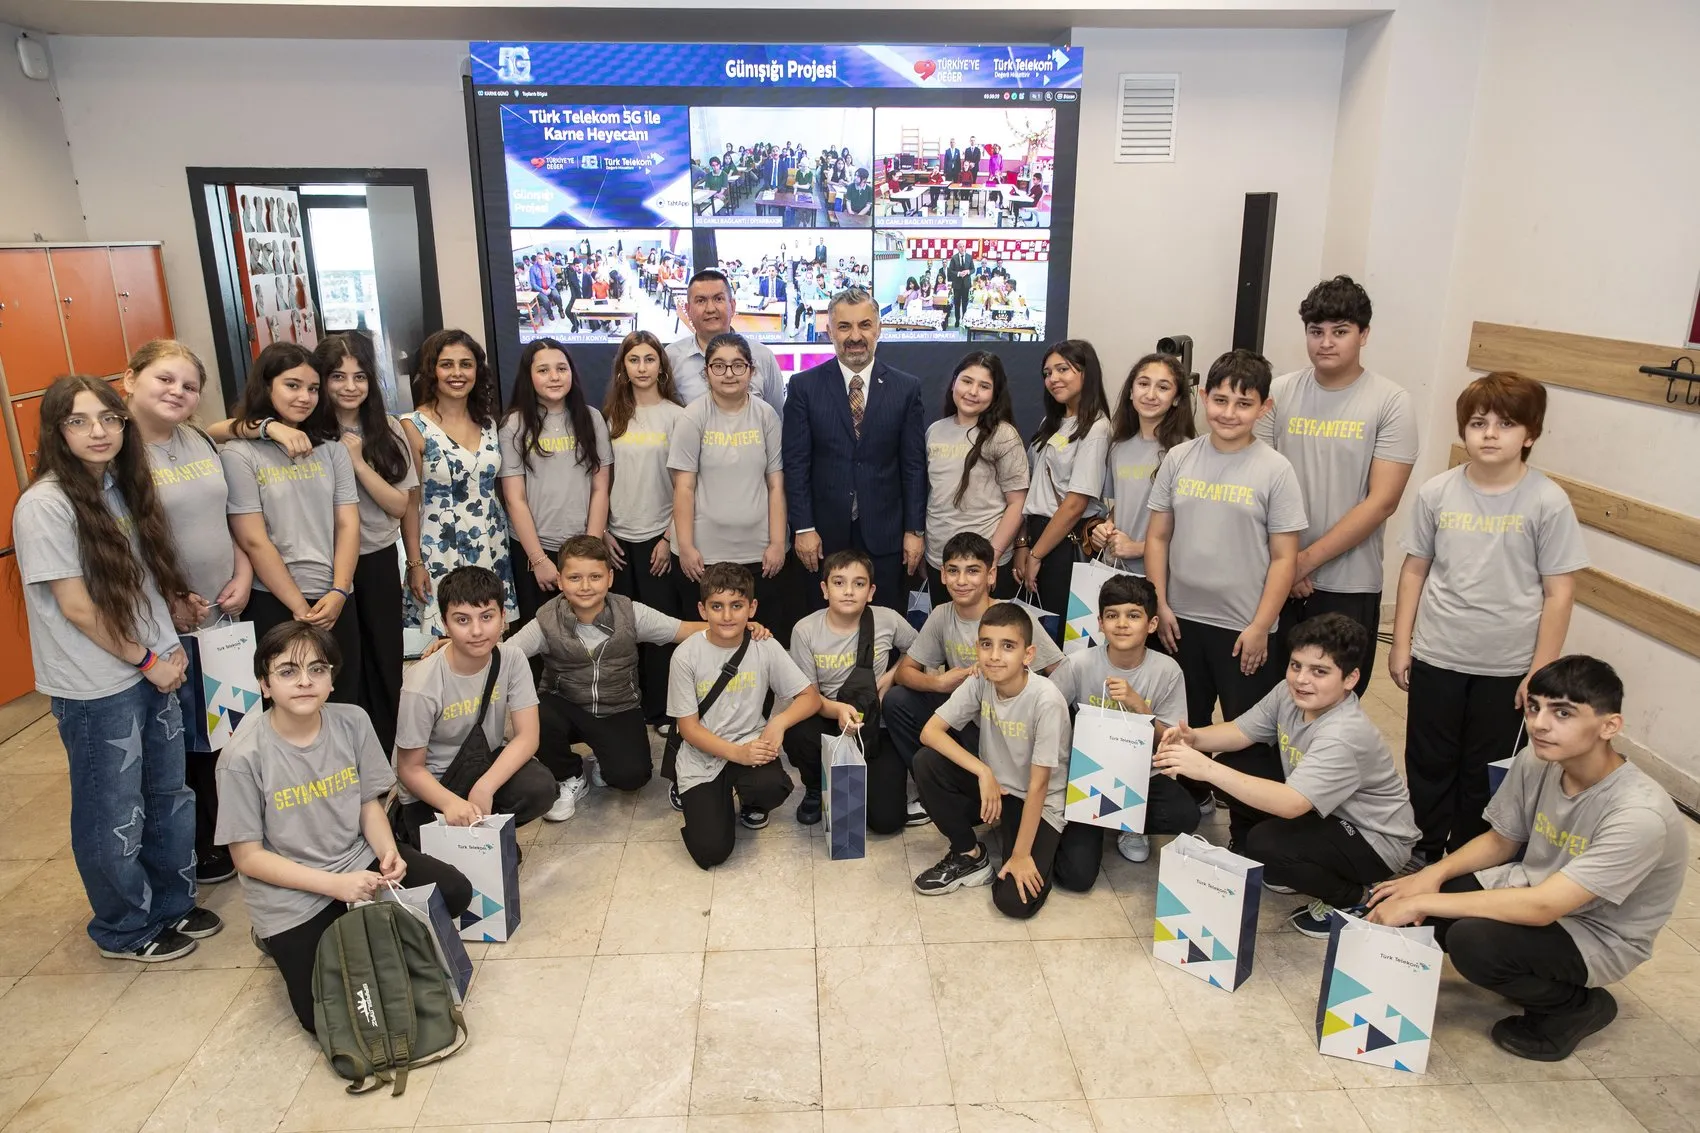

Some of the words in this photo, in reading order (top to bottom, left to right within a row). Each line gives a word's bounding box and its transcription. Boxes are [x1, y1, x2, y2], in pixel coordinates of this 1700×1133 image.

[498, 46, 532, 81] 5G
[725, 59, 784, 82] Günışığı
[787, 59, 837, 82] Projesi
[937, 57, 980, 71] TÜRKİYE'YE
[994, 58, 1013, 71] Türk
[1015, 58, 1053, 72] Telekom
[937, 71, 963, 83] DEĞER
[529, 110, 560, 124] Türk
[563, 110, 620, 125] Telekom
[623, 110, 641, 124] 5G
[644, 110, 661, 125] ile
[544, 127, 584, 141] Karne
[587, 127, 648, 143] Heyecanı
[604, 158, 620, 166] Türk
[622, 157, 652, 167] Telekom
[1288, 417, 1365, 440] SEYRANTEPE
[703, 429, 761, 447] SEYRANTEPE
[1176, 477, 1254, 506] SEYRANTEPE
[1439, 511, 1526, 535] SEYRANTEPE
[1380, 953, 1393, 961] Türk
[1394, 956, 1420, 969] Telekom
